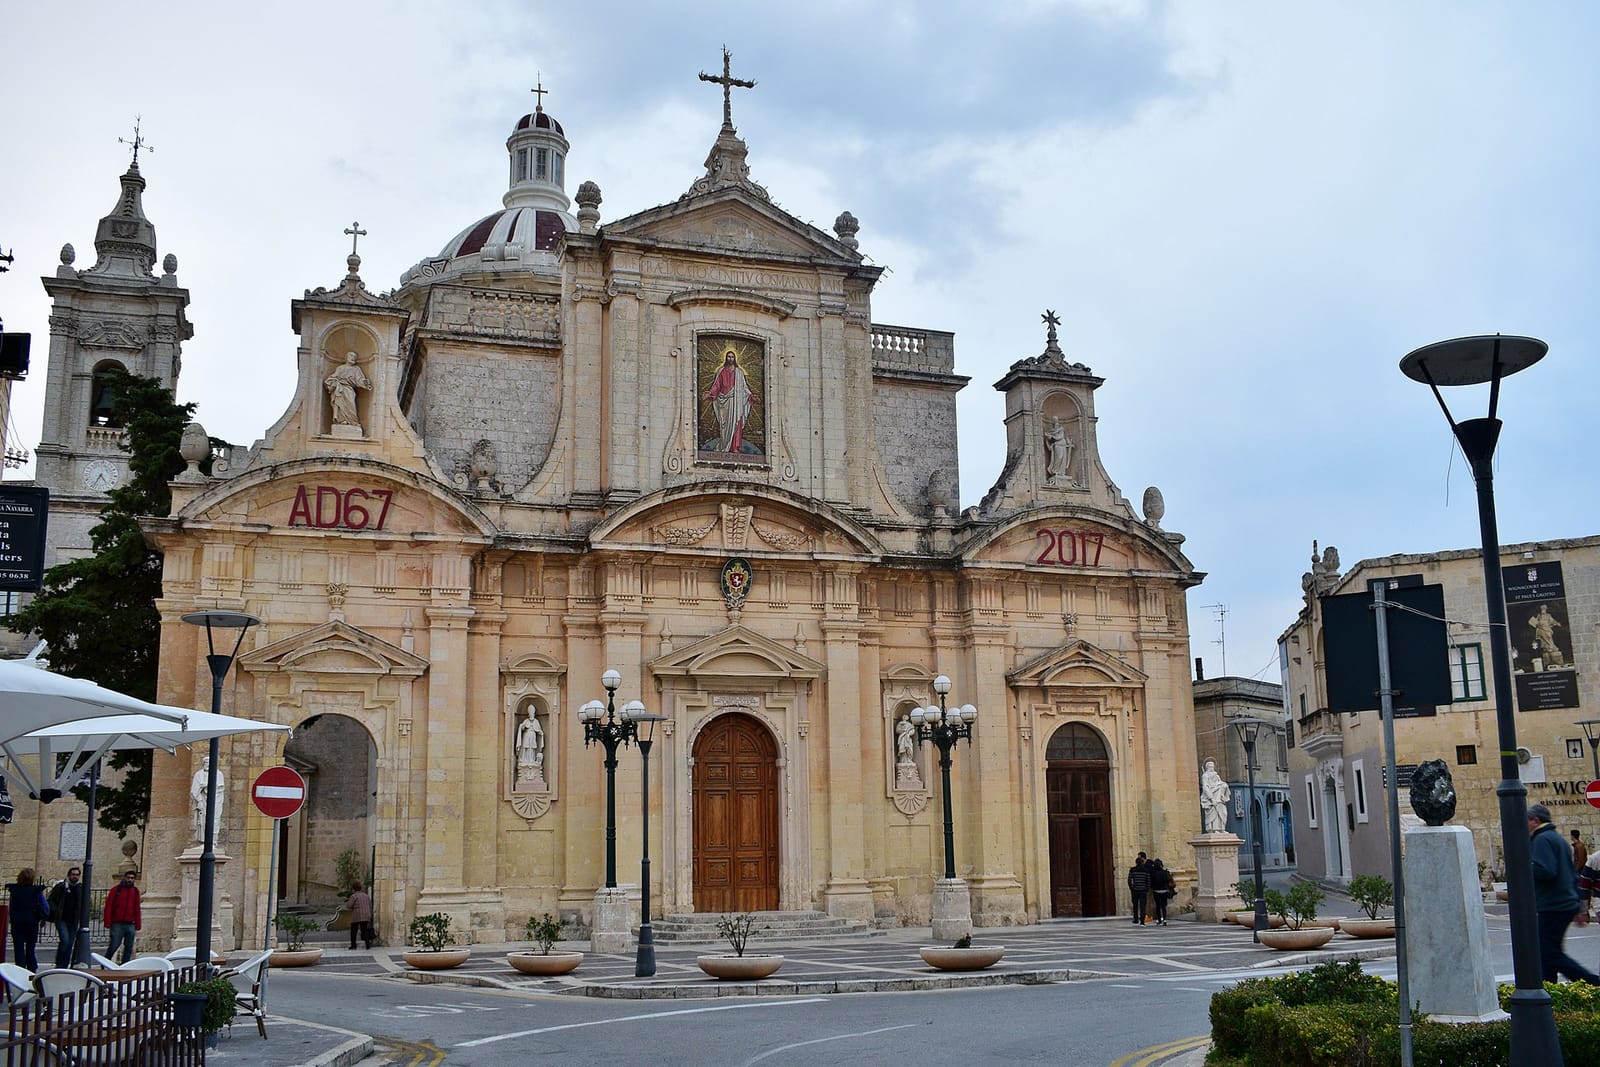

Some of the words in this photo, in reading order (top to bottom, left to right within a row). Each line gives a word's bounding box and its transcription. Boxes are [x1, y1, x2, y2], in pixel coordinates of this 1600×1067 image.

[5, 504, 33, 513] NAVARRA
[288, 484, 393, 531] AD67
[1036, 528, 1104, 567] 2017
[1552, 780, 1591, 795] WIG
